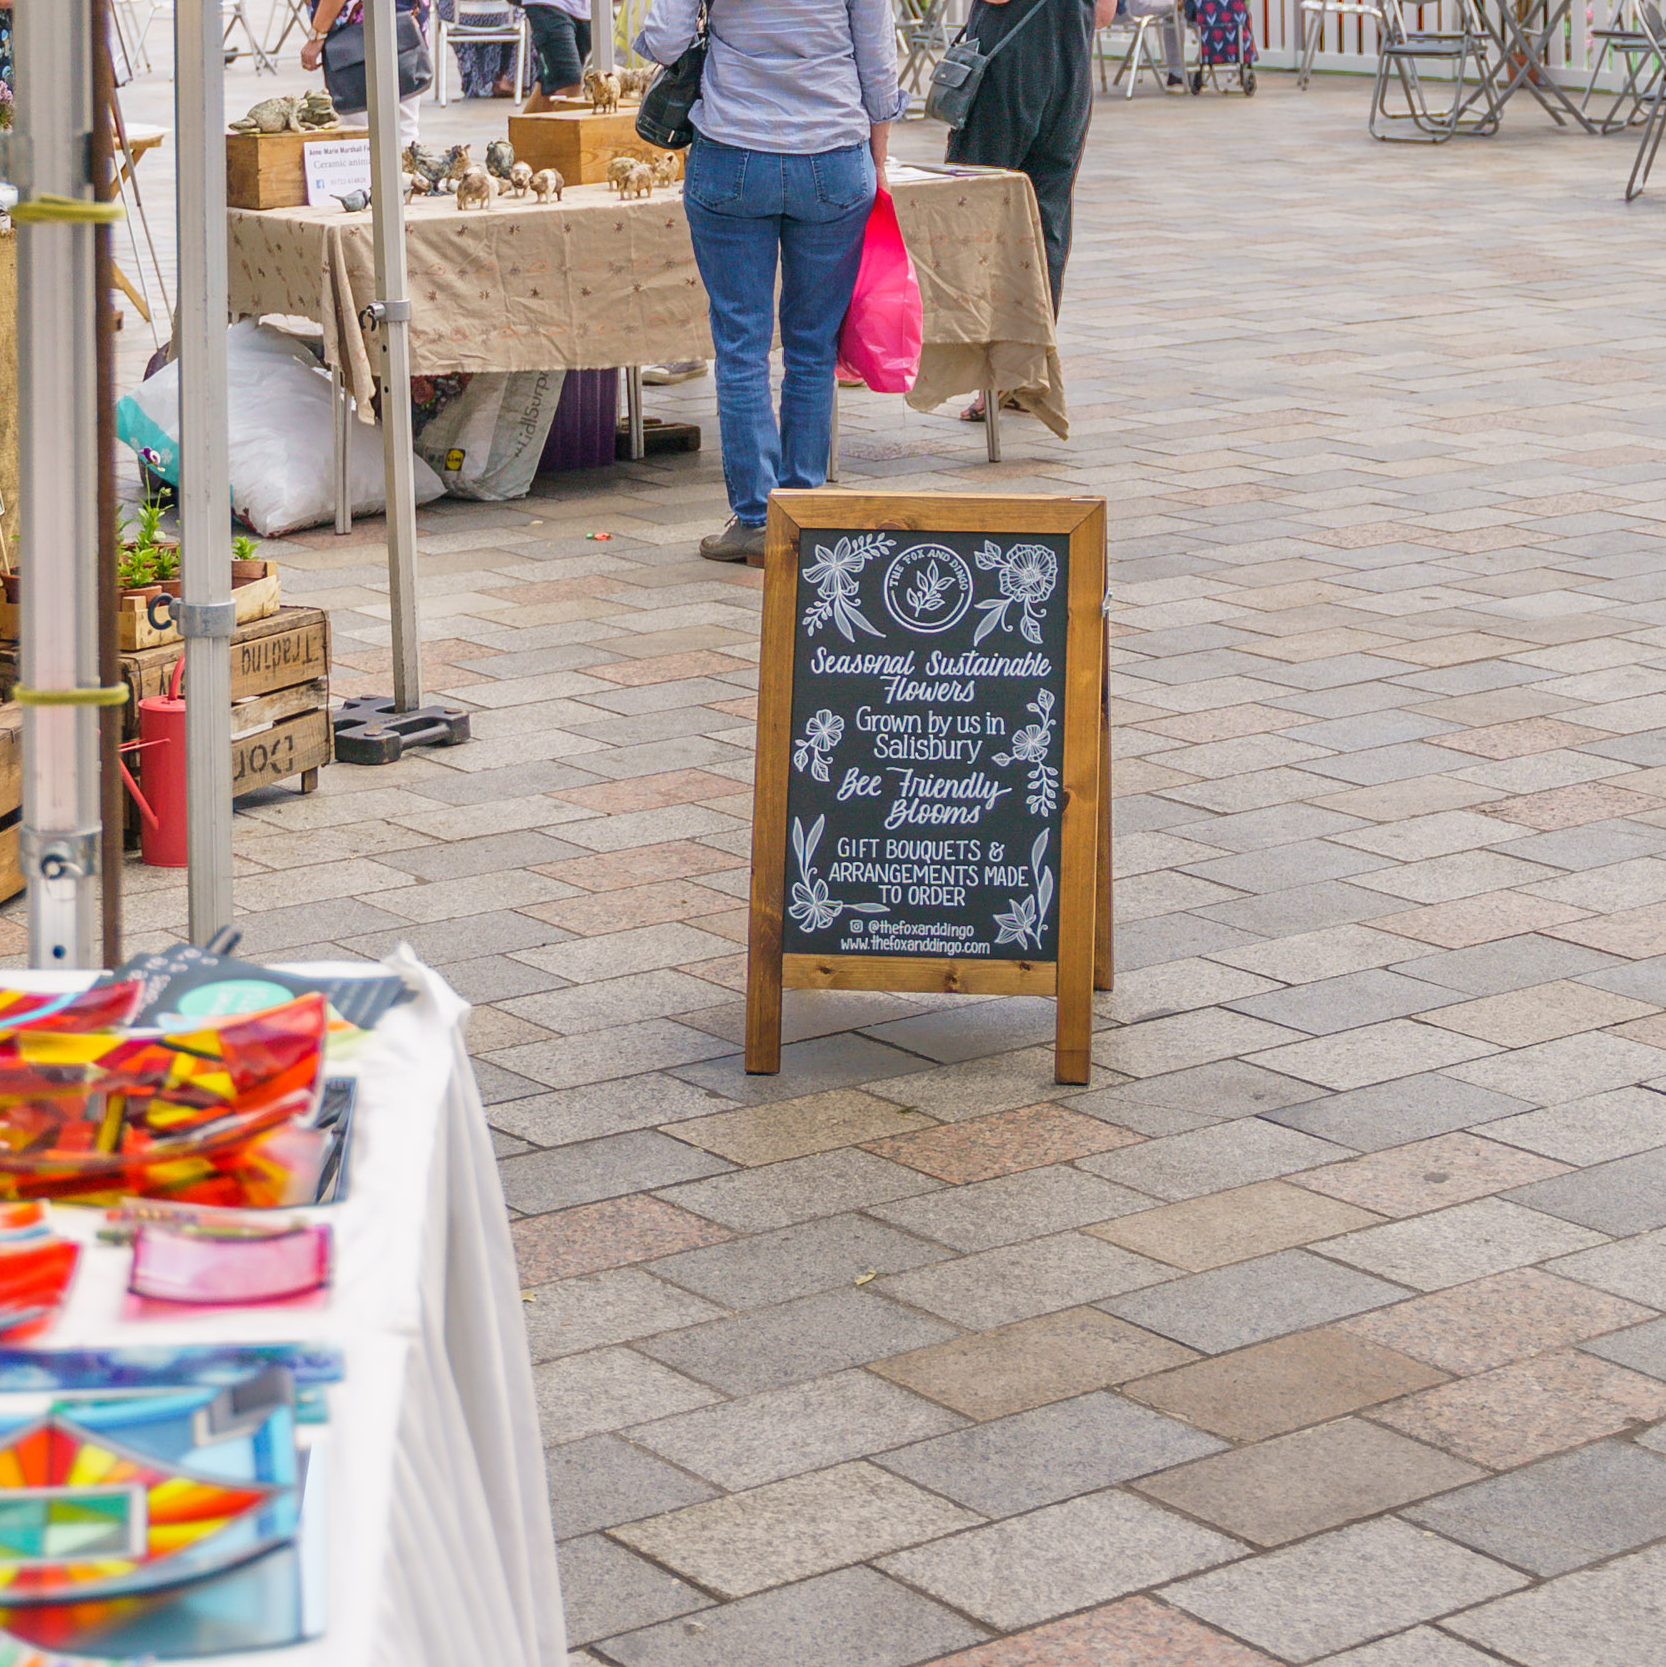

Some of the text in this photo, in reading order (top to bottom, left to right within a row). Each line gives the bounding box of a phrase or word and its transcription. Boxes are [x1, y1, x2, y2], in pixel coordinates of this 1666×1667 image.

[313, 158, 346, 170] Ceramic
[889, 549, 969, 591] THE FOX AND DINGO
[811, 646, 1052, 677] Seasonal Sustainable
[880, 675, 975, 704] Flowers
[855, 706, 1006, 736] Grown by us in
[874, 734, 982, 764] Salisbury
[837, 767, 1013, 810] Bee Friendly
[884, 798, 982, 830] Blooms
[837, 837, 1005, 863] GIFT BOUQUETS &
[828, 862, 1030, 887] ARRANGEMENTS MADE
[878, 885, 965, 906] TO ORDER
[868, 919, 975, 940] @thefoxanddingo
[841, 935, 991, 956] www.thefoxanddingo.com
